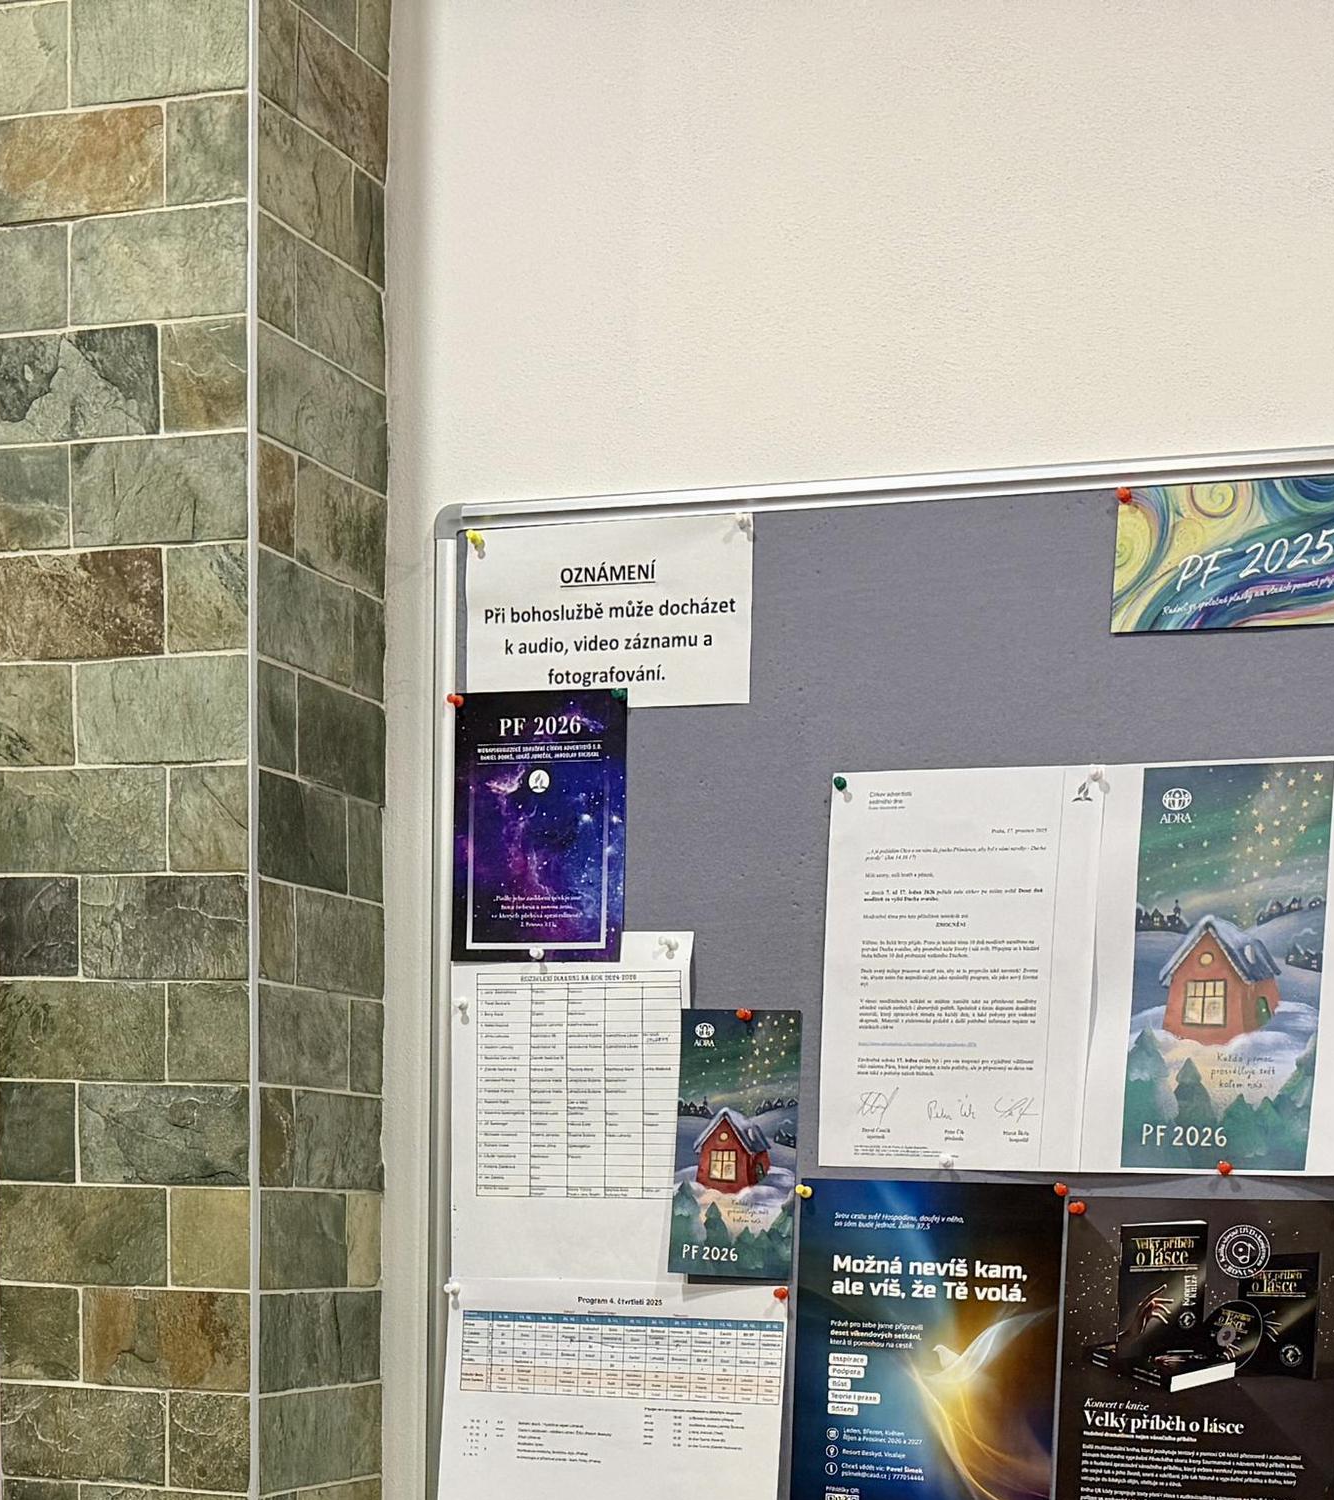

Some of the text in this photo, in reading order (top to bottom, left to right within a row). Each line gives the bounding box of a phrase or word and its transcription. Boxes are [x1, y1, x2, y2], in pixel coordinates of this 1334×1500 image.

[560, 560, 656, 585] OZNÁMENÍ
[1177, 553, 1223, 592] PF
[484, 598, 736, 624] Při bohoslužbě může docházet
[505, 633, 712, 657] k audio, video záznamu a
[548, 665, 665, 688] fotografování.
[499, 716, 581, 736] PF 2026
[1160, 812, 1192, 824] ADRA
[693, 1039, 715, 1048] ADRA
[1141, 1124, 1228, 1147] PF 2026
[682, 1244, 738, 1262] PF 2026
[1136, 1248, 1189, 1266] o lásce
[833, 1255, 1028, 1282] Možná nevíš kam,
[832, 1279, 1027, 1303] ale víš, že Tě volá.
[1084, 1410, 1245, 1434] Velký příběh o lásce
